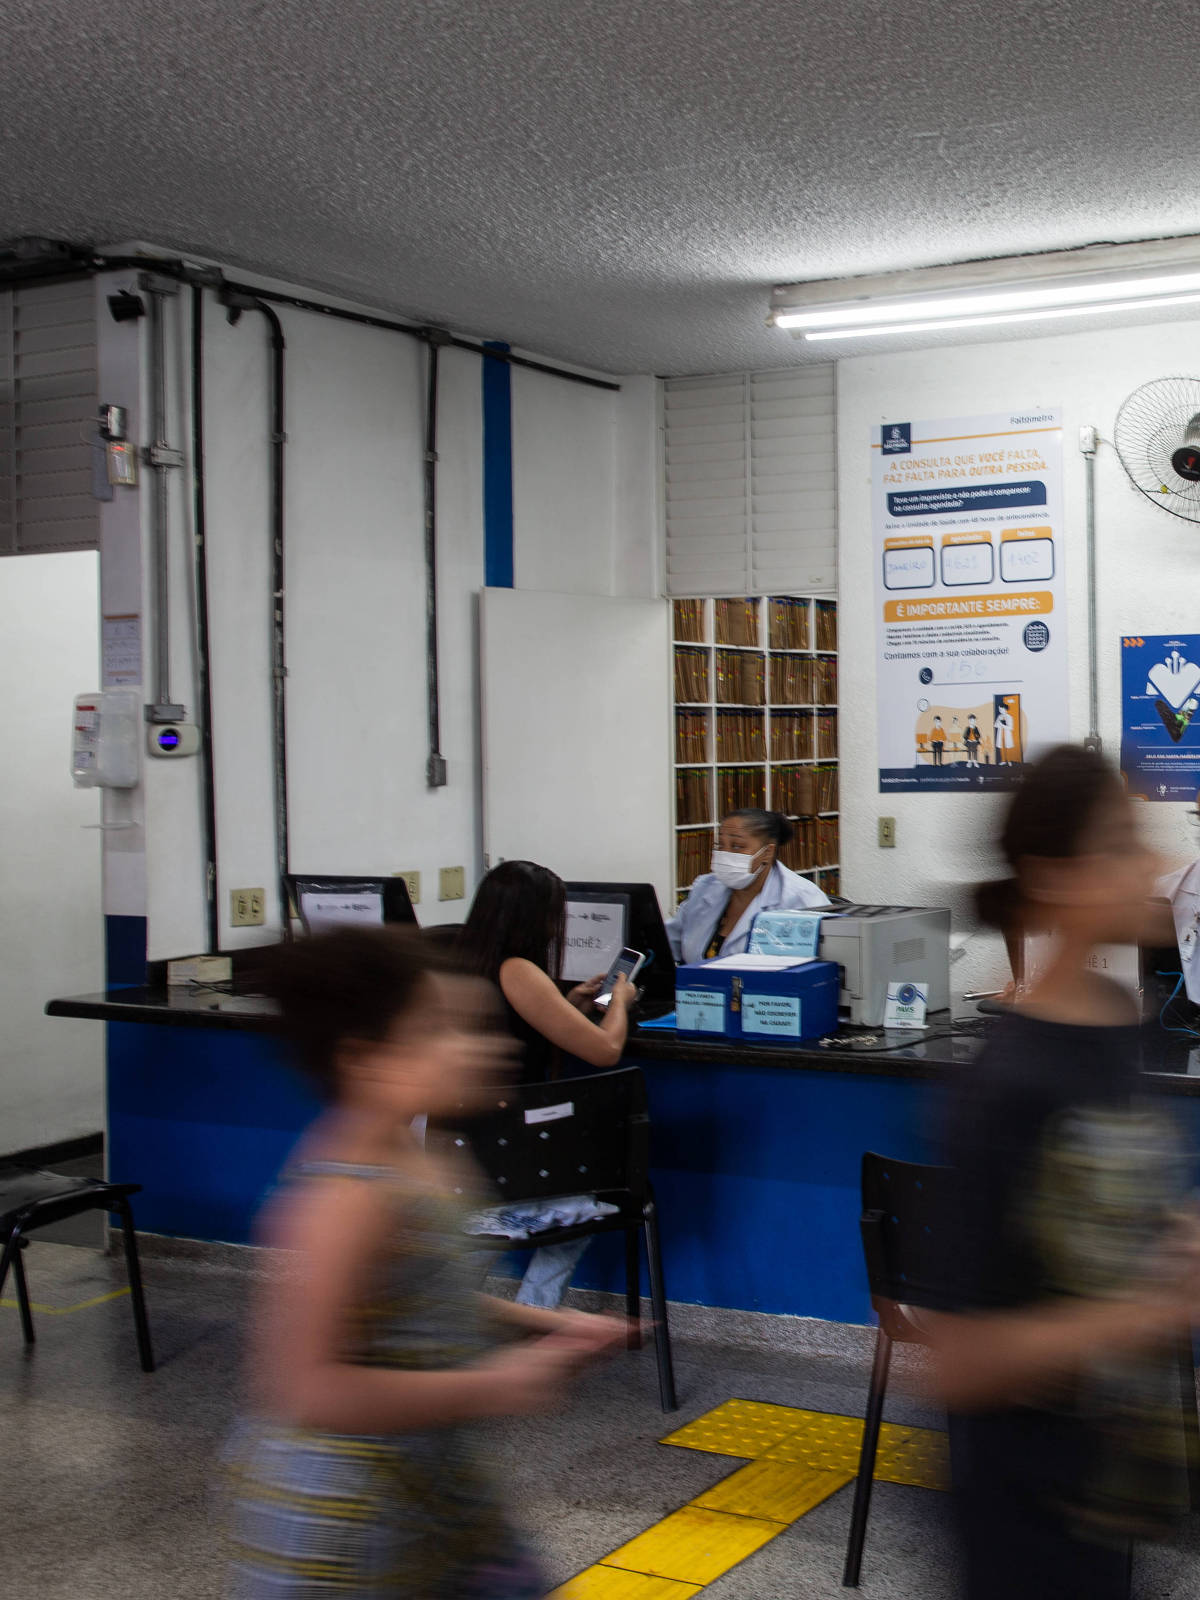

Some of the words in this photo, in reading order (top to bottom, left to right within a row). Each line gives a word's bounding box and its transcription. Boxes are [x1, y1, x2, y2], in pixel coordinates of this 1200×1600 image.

[900, 456, 951, 471] CONSULTA
[954, 455, 975, 465] QUE
[978, 450, 1004, 463] VOCÊ
[883, 475, 902, 484] FAZ
[904, 471, 935, 482] FALTA
[938, 468, 966, 479] PARA
[969, 465, 1003, 476] OUTRA
[896, 603, 905, 617] É
[907, 601, 984, 617] IMPORTANTE
[986, 597, 1041, 612] SEMPRE:
[945, 649, 960, 657] sua
[567, 936, 593, 949] UICHÊ
